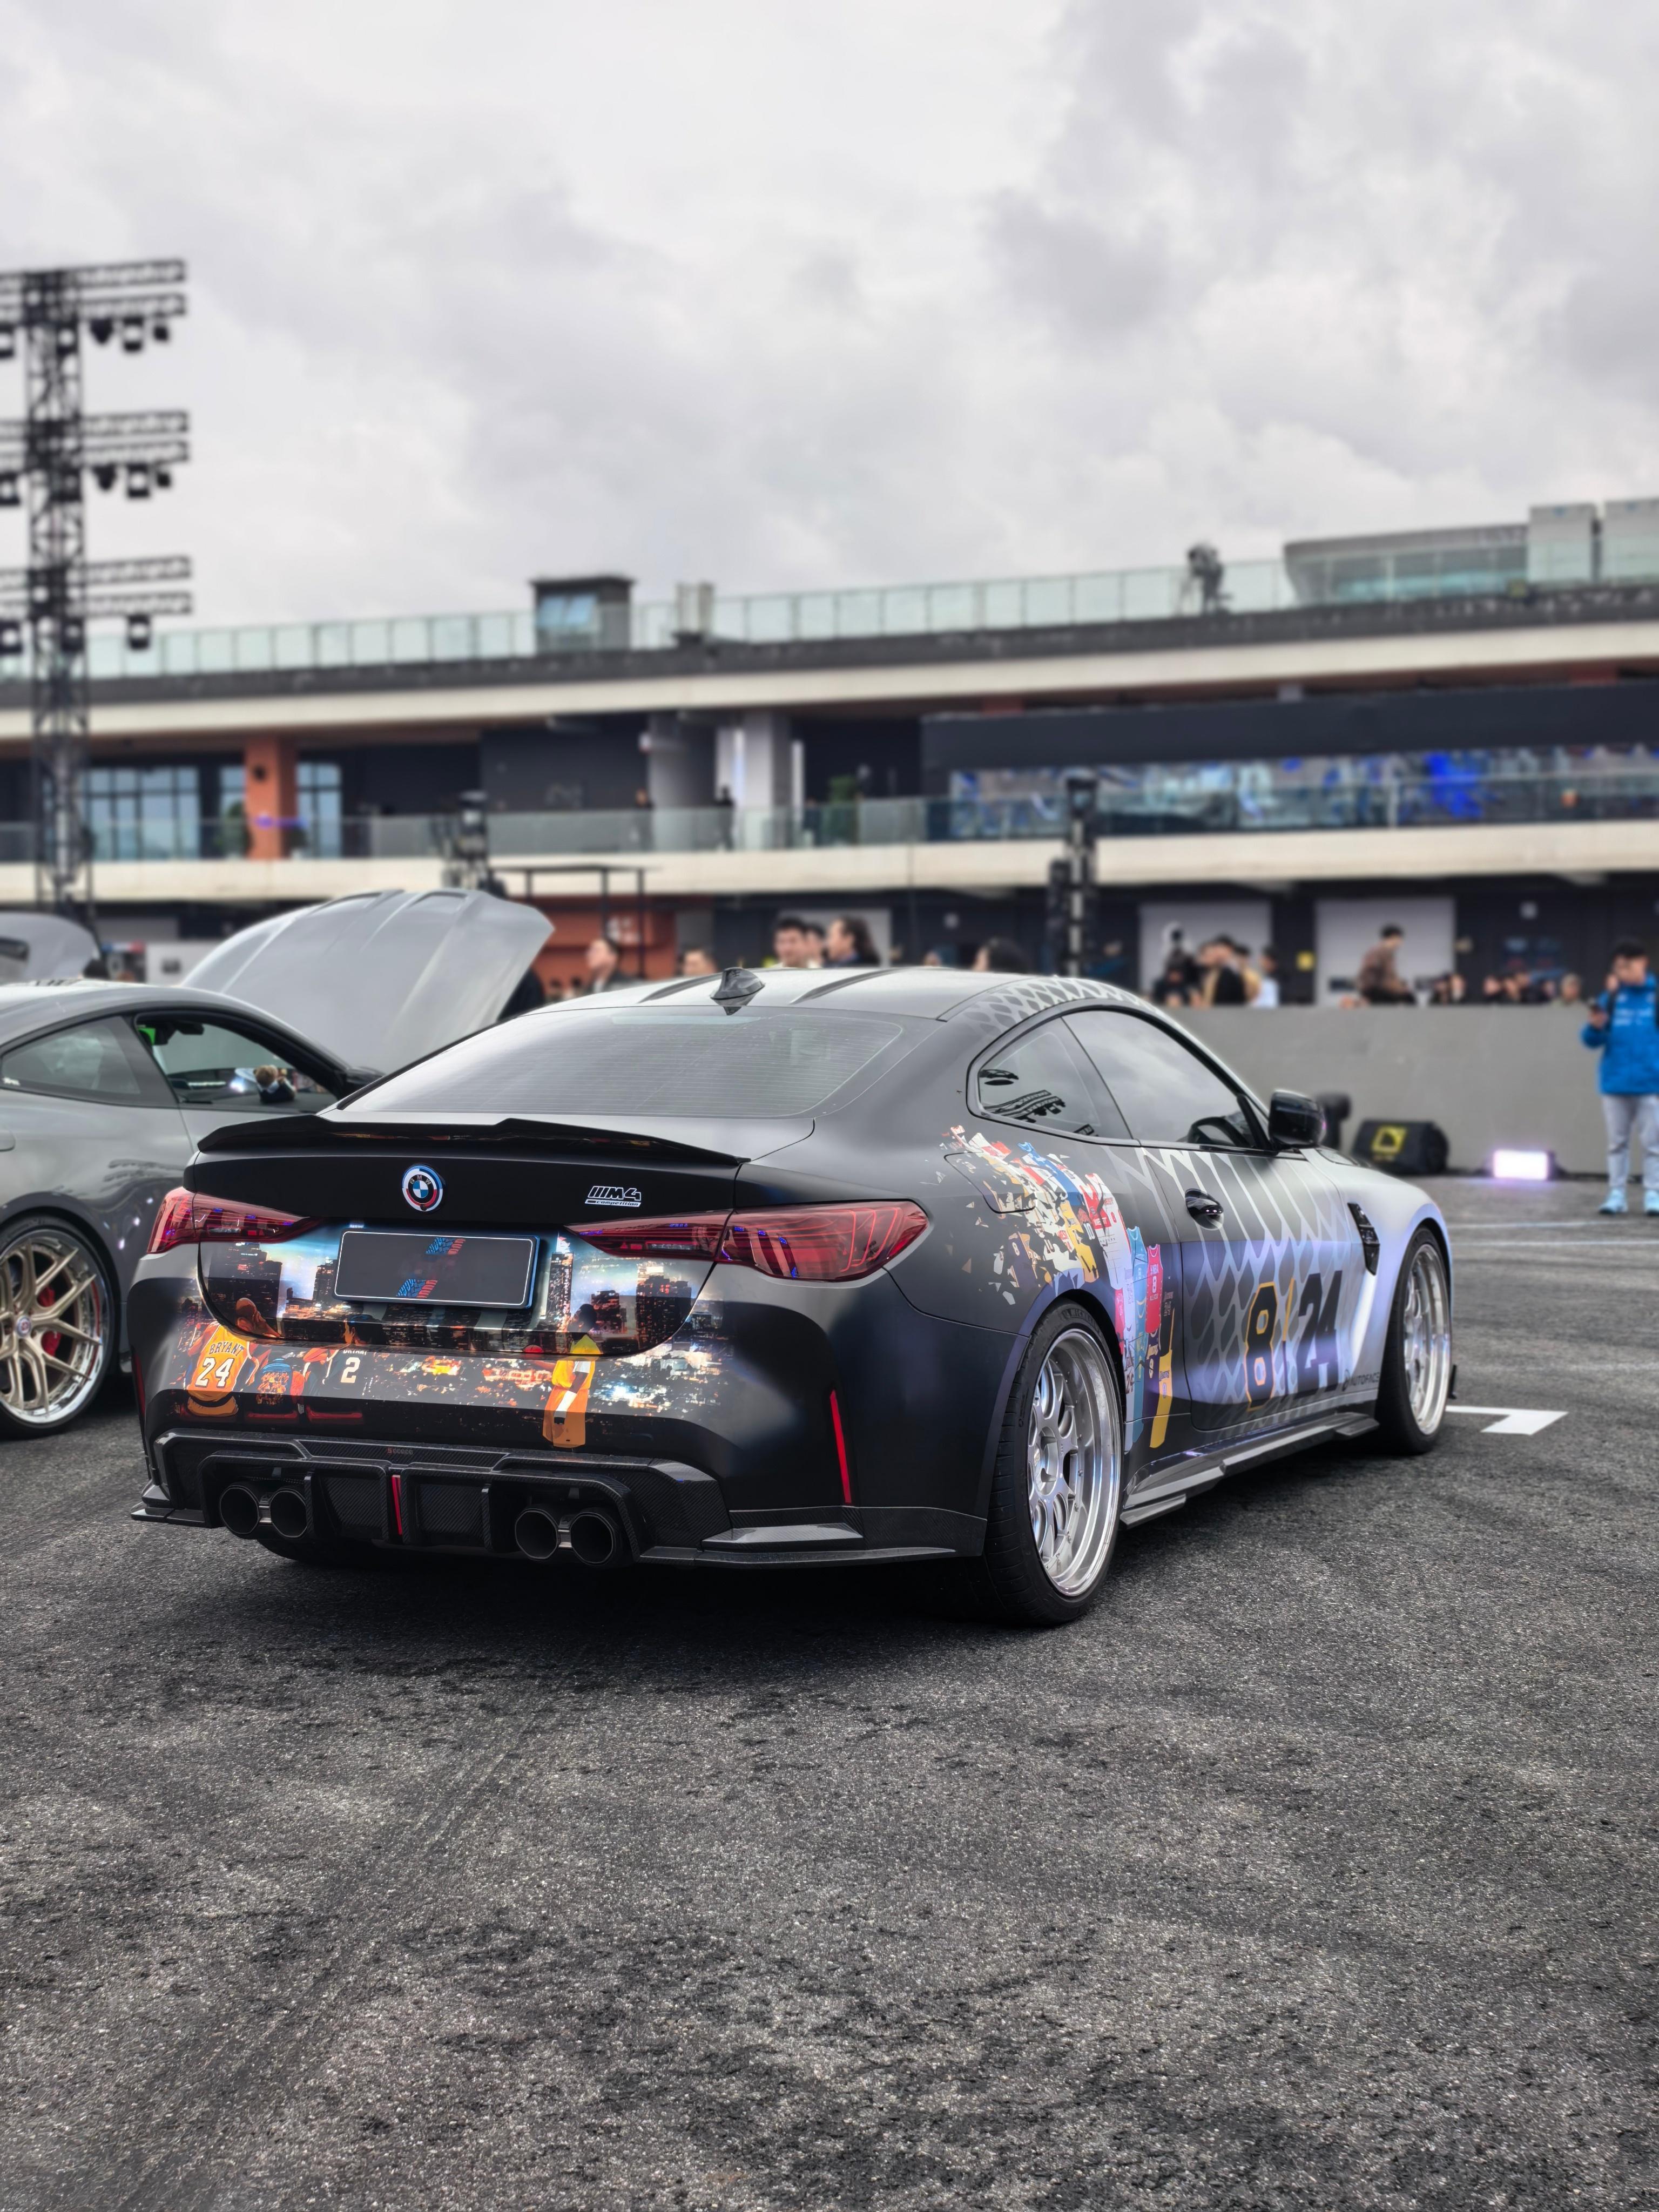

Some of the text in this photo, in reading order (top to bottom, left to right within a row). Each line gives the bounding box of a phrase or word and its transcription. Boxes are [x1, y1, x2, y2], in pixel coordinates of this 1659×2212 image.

[409, 1175, 431, 1185] BMW
[209, 1341, 245, 1357] BRYANT
[195, 1357, 234, 1389] 24
[340, 1357, 361, 1384] 2
